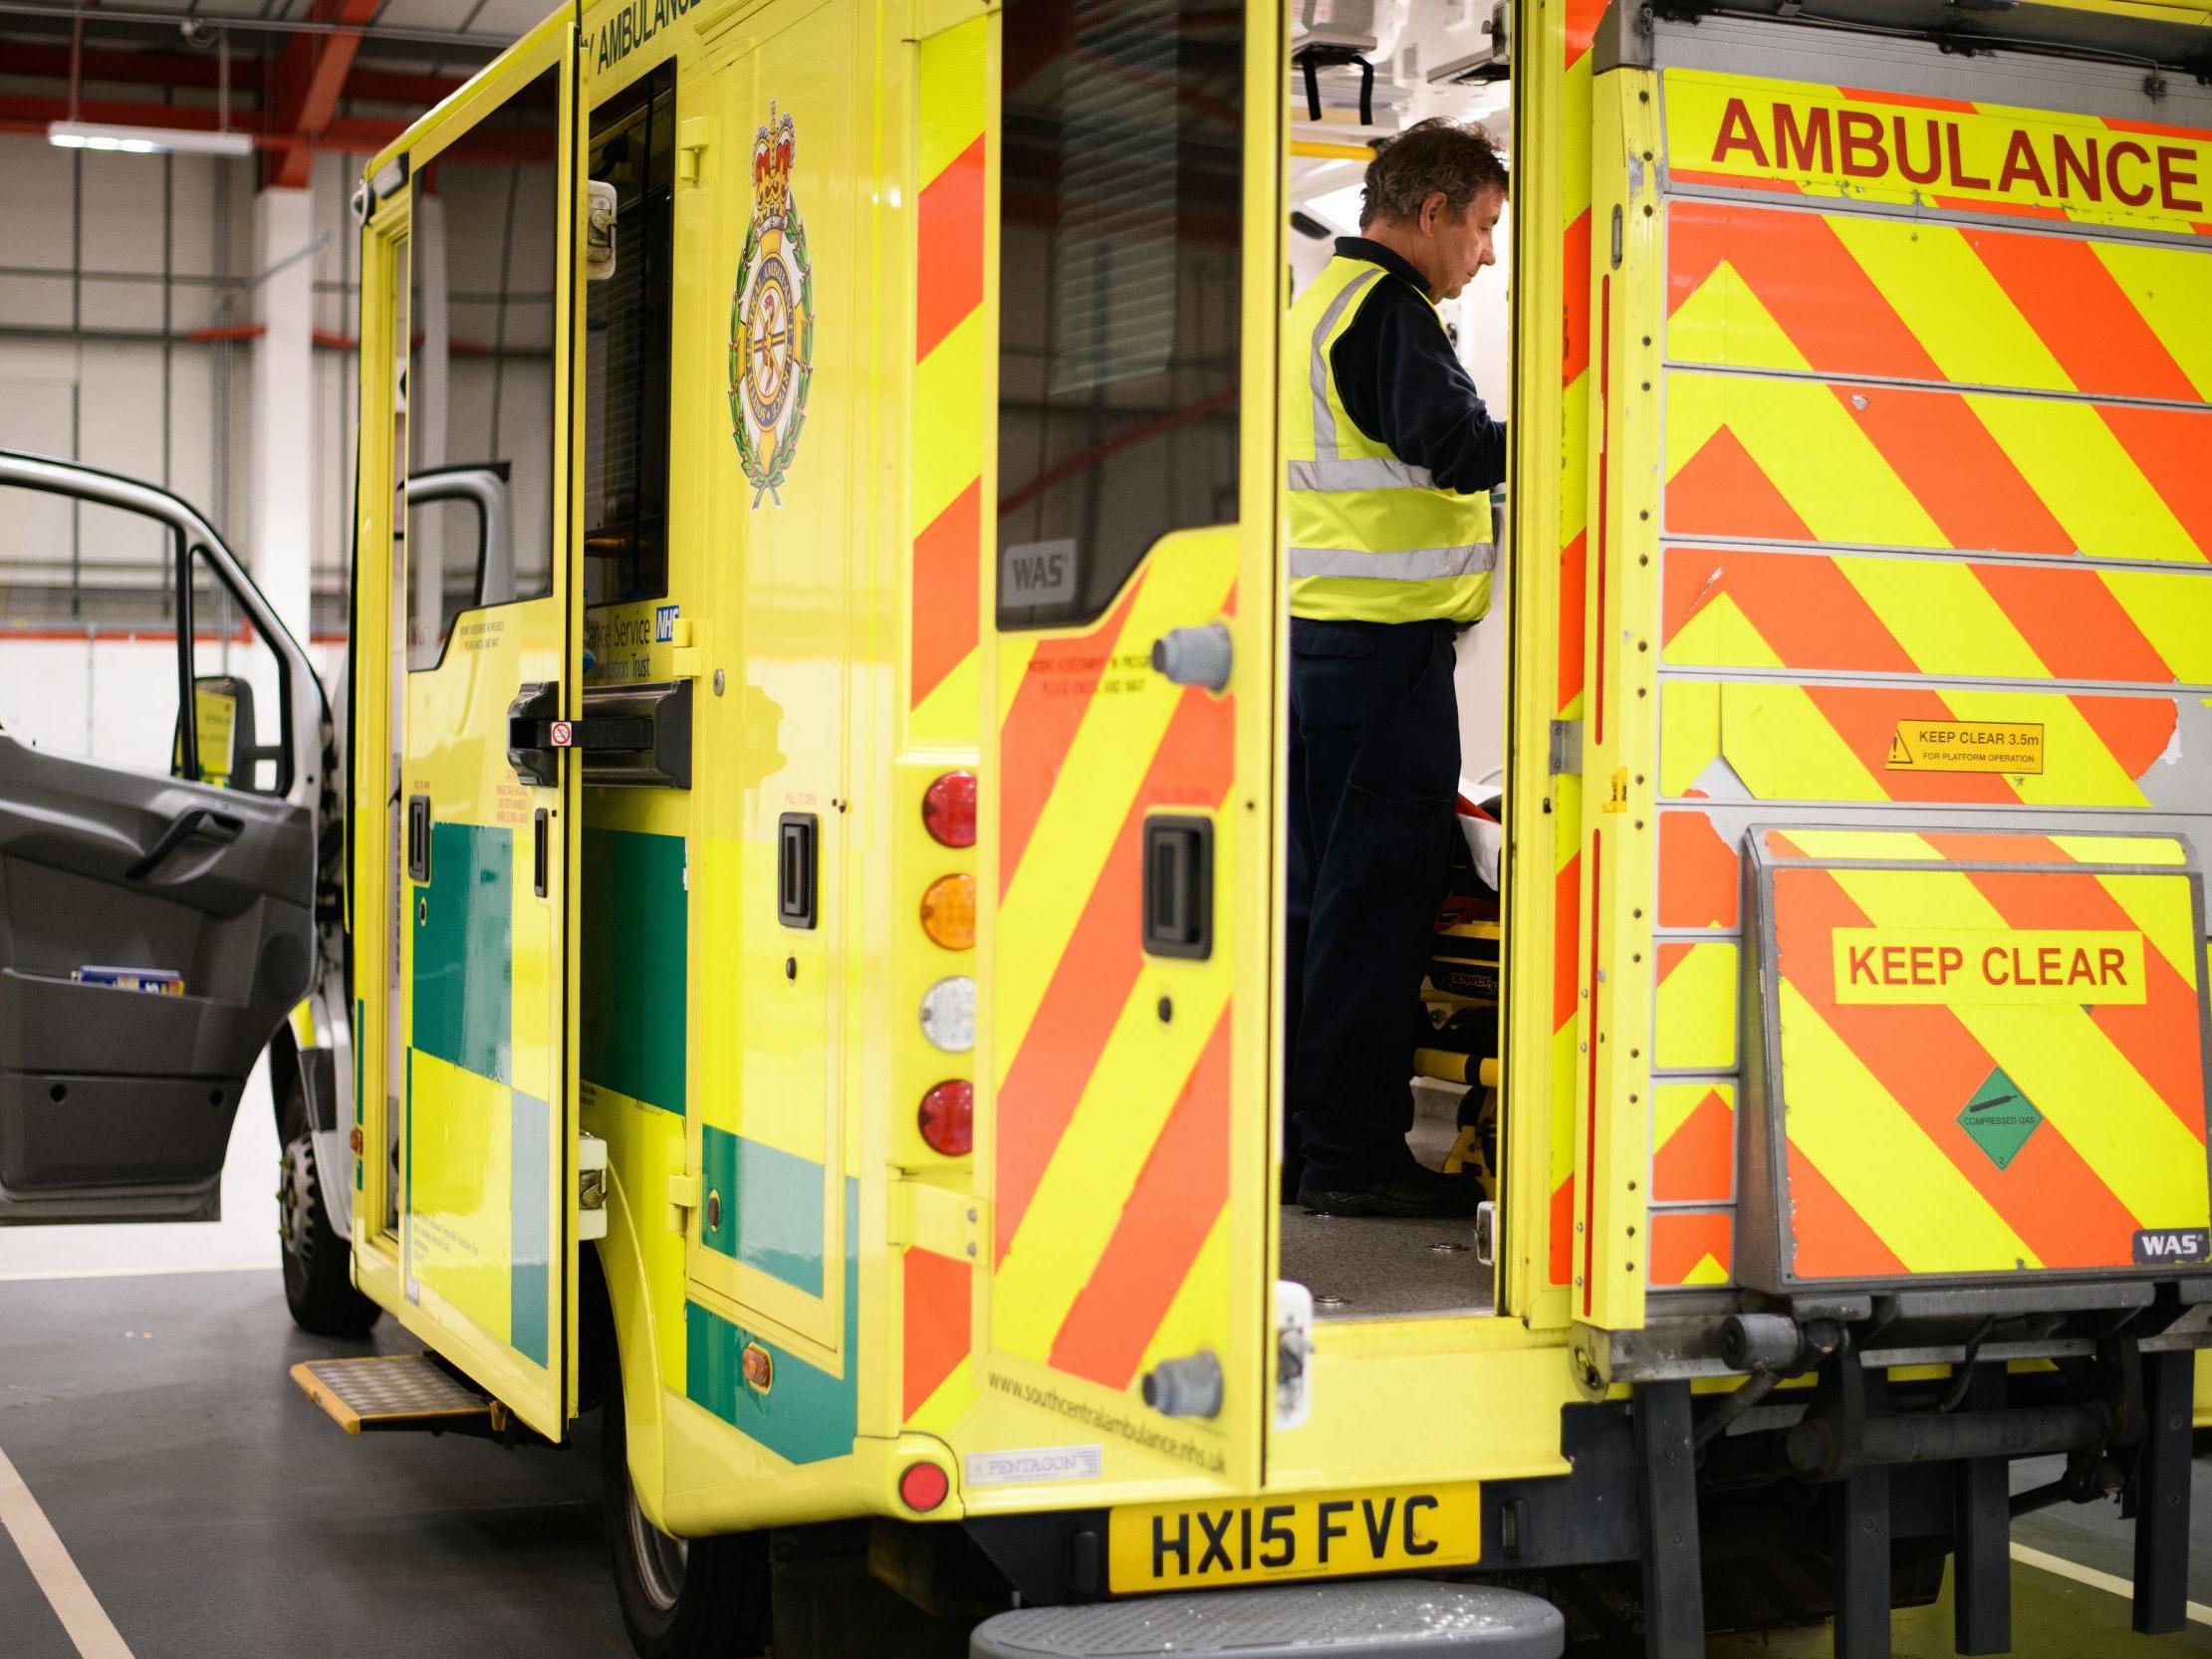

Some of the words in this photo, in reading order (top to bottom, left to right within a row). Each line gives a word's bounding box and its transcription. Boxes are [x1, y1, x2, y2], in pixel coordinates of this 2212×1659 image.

[598, 0, 701, 76] AMBULA
[1711, 98, 2203, 213] AMBULANCE
[1012, 554, 1064, 592] WAS
[614, 609, 650, 647] Service
[631, 653, 650, 678] Trust
[1918, 730, 1956, 743] KEEP
[1959, 731, 2005, 745] CLEAR
[2008, 733, 2040, 746] 3.5m
[1922, 752, 1940, 761] FOR
[1941, 752, 1987, 762] PLATFORM
[1988, 754, 2035, 764] OPERATION
[1848, 945, 1964, 985] KEEP
[1981, 946, 2128, 986] CLEAR
[1964, 1115, 2018, 1125] COMPRESSED
[2018, 1115, 2036, 1125] GAS
[1152, 1504, 1296, 1578] HX15
[1318, 1494, 1439, 1564] FVC
